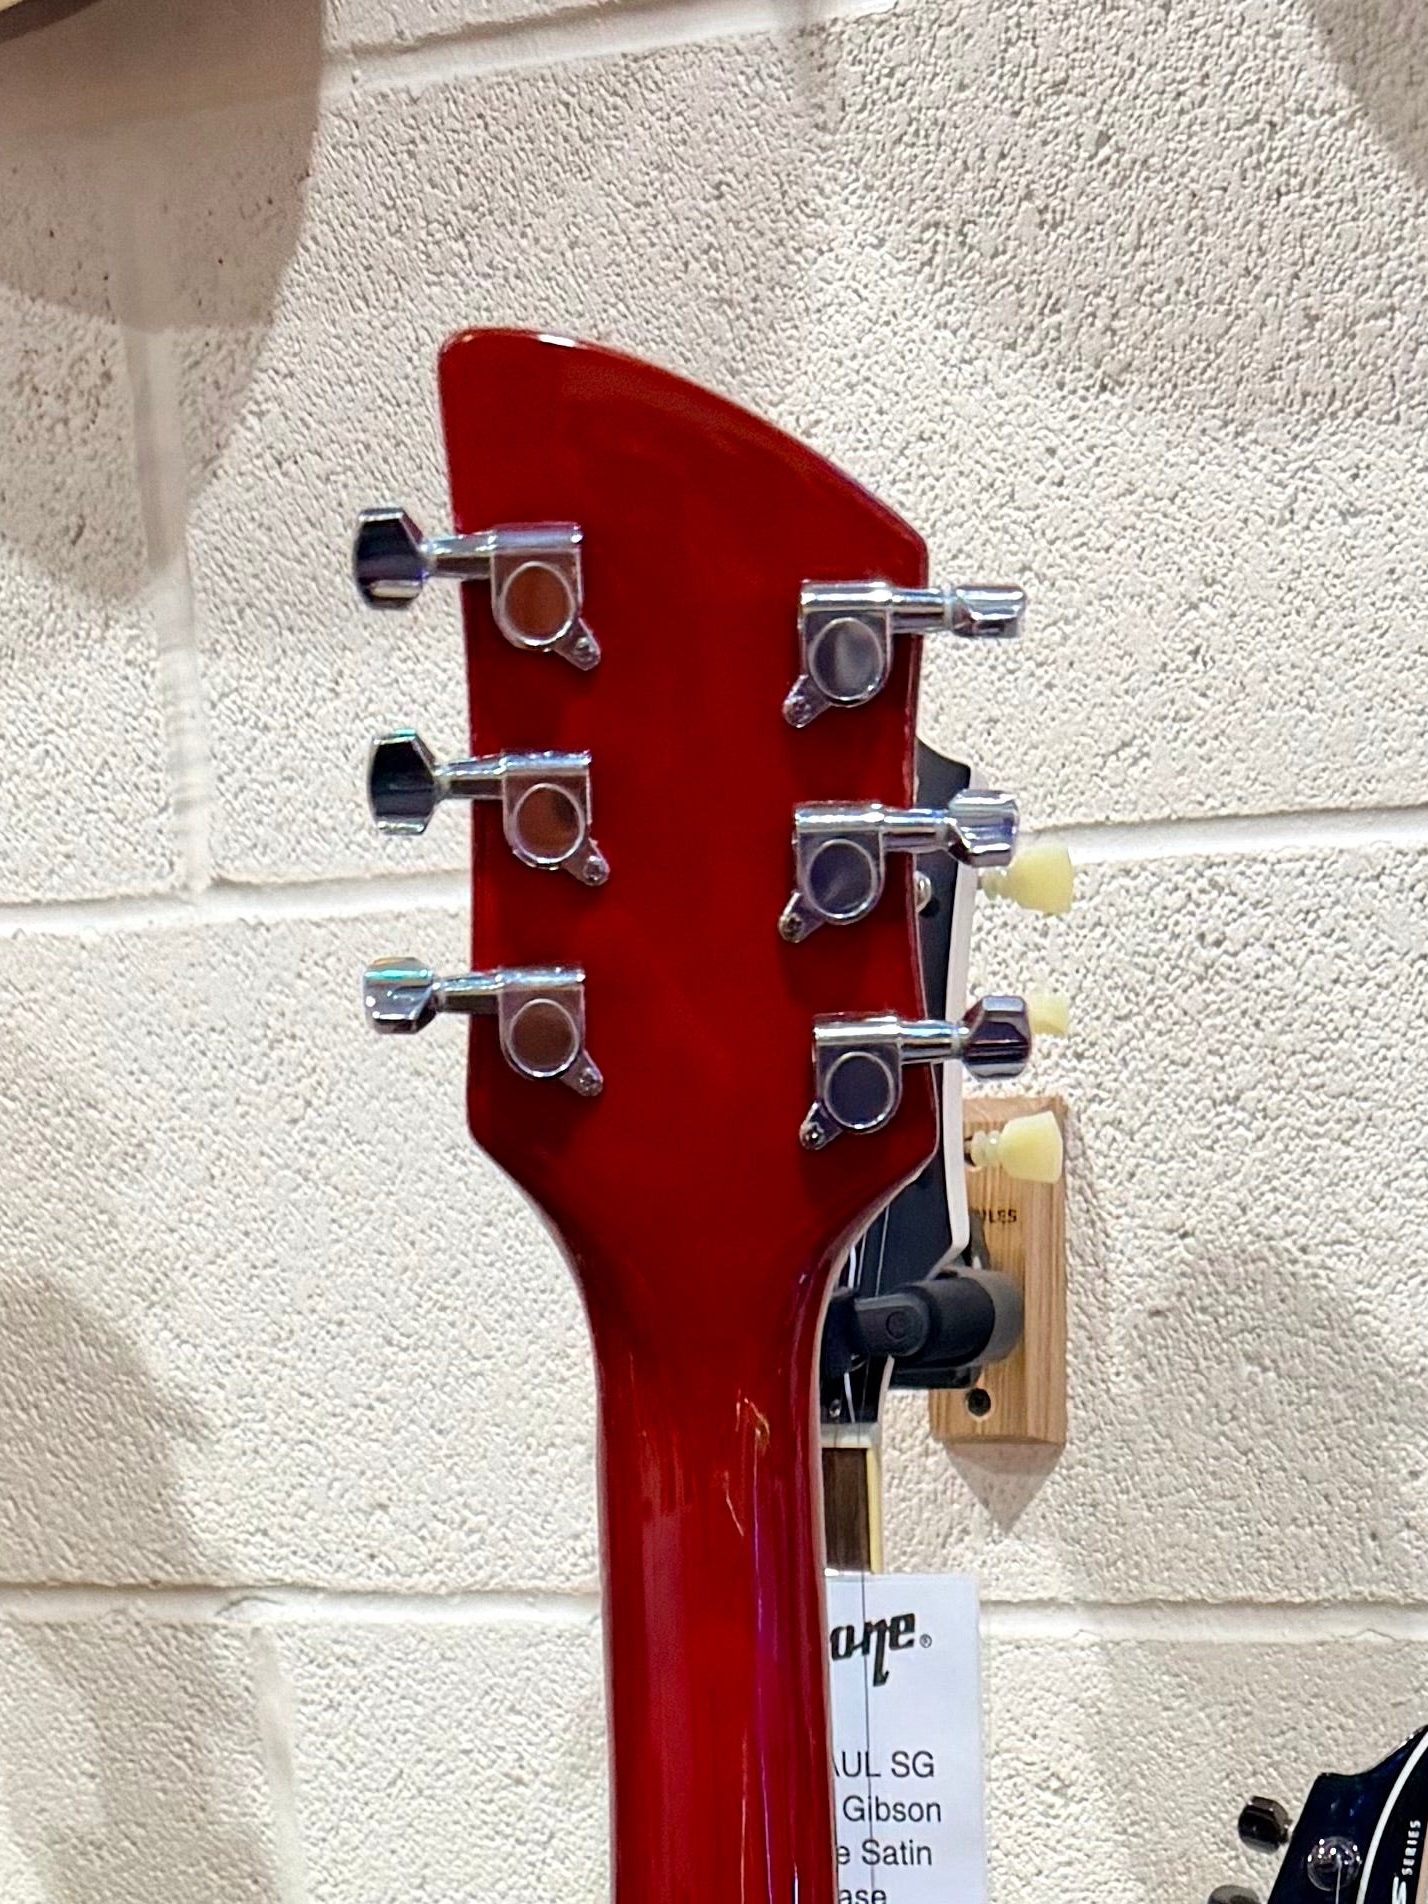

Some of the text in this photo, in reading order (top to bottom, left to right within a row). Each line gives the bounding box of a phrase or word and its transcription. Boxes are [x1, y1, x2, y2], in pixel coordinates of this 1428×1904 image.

[891, 1751, 936, 1779] SG
[842, 1795, 943, 1824] Gibson
[861, 1840, 934, 1867] Satin
[1400, 1819, 1422, 1876] SERIES
